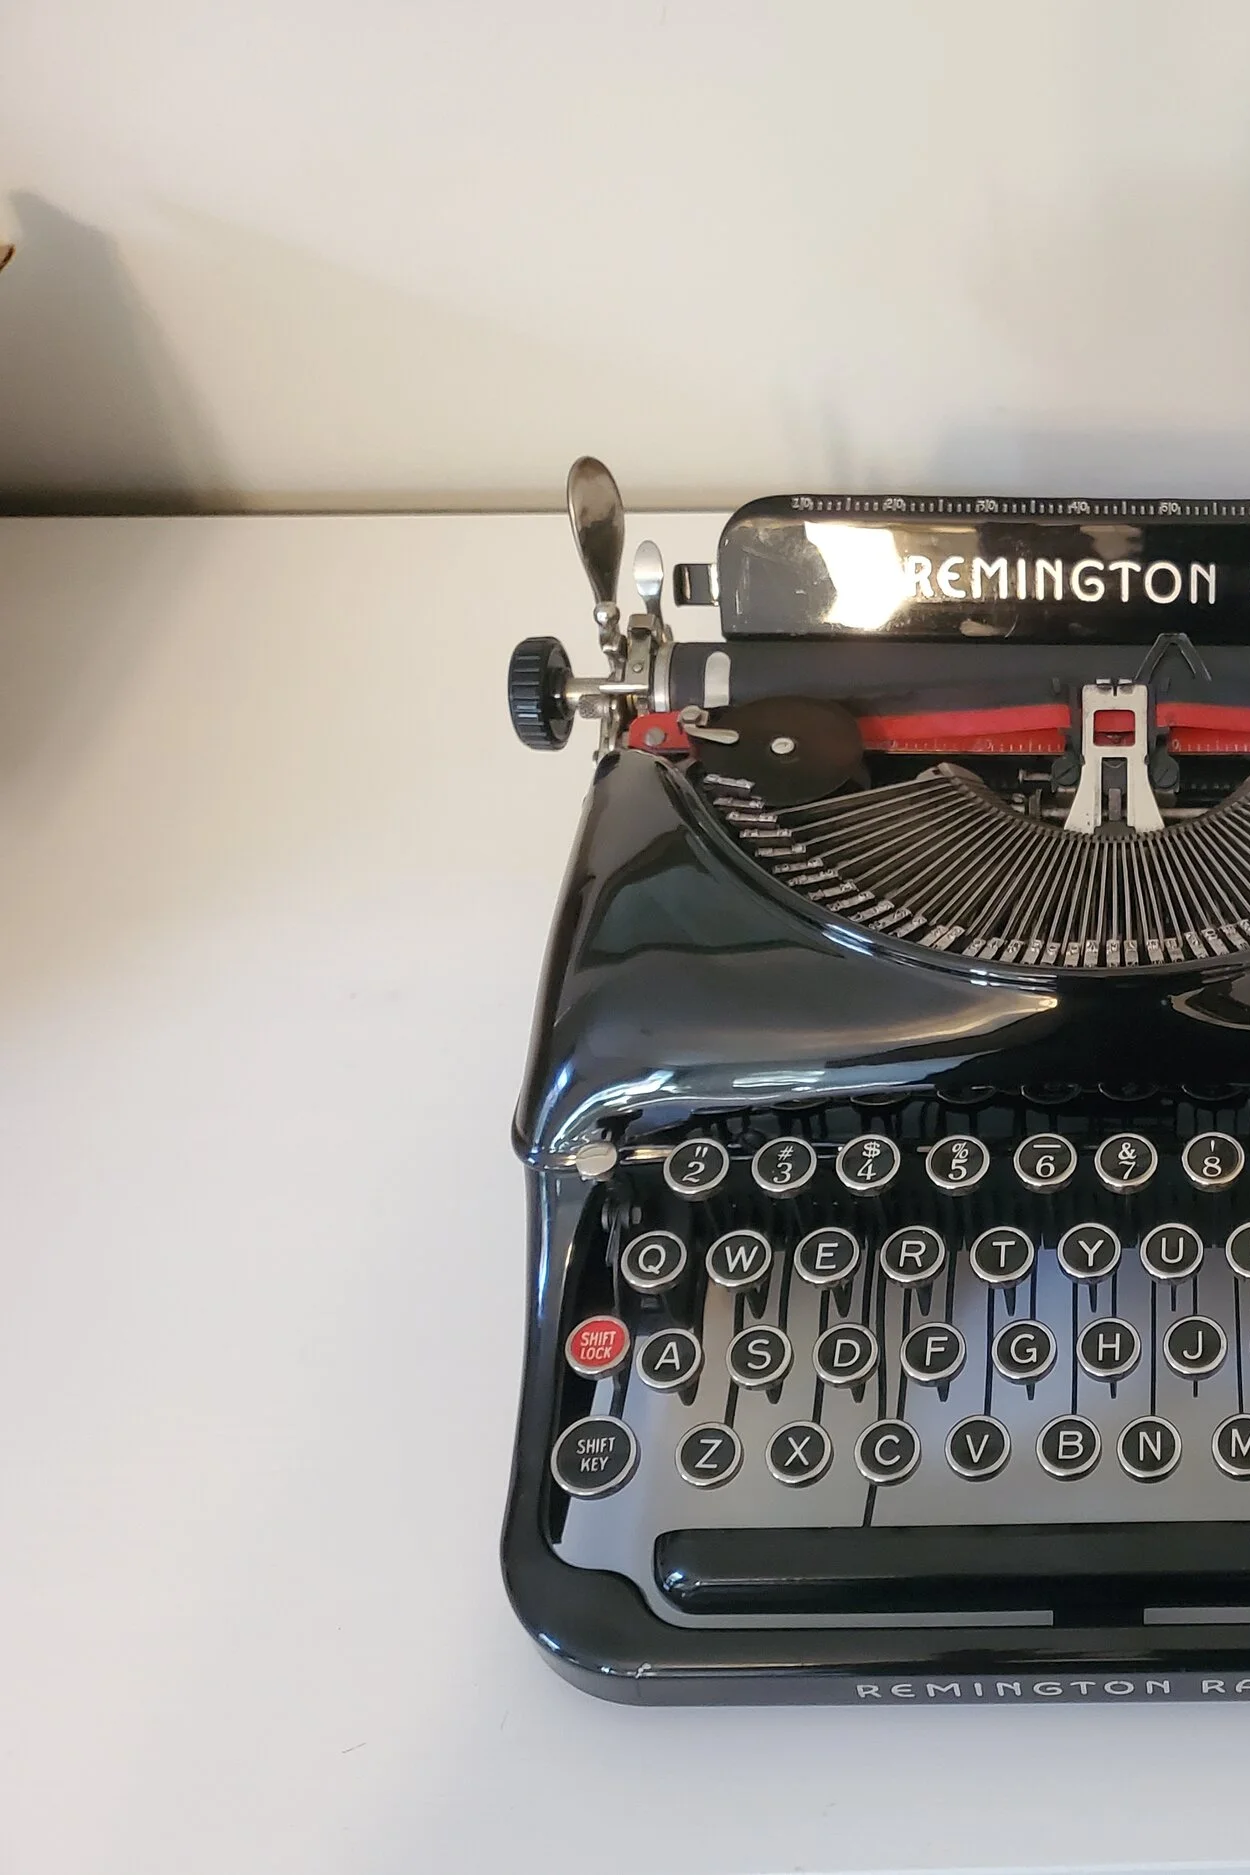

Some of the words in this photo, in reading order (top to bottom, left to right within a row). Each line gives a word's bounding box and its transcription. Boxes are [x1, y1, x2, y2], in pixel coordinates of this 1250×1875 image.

[1161, 502, 1179, 514] 50
[907, 554, 1216, 604] REMINGTON
[695, 1145, 709, 1158] "
[777, 1145, 794, 1161] #
[862, 1141, 881, 1159] $
[951, 1141, 969, 1159] %
[1117, 1142, 1137, 1160] &
[682, 1161, 705, 1183] 2
[773, 1162, 793, 1184] 3
[857, 1158, 877, 1181] 4
[948, 1158, 968, 1181] 5
[1035, 1155, 1055, 1178] 6
[1118, 1160, 1136, 1181] 7
[1202, 1156, 1222, 1177] 8
[638, 1243, 666, 1275] Q
[725, 1245, 759, 1273] W
[815, 1242, 839, 1270] E
[899, 1240, 926, 1268] R
[992, 1240, 1016, 1268] T
[1078, 1239, 1104, 1267] Y
[1161, 1236, 1184, 1264] U
[580, 1330, 617, 1347] SHIFT
[833, 1338, 861, 1367] D
[925, 1336, 949, 1366] F
[1010, 1333, 1037, 1364] G
[1098, 1332, 1121, 1361] H
[1182, 1330, 1203, 1360] J
[580, 1346, 613, 1360] LOCK
[654, 1341, 680, 1371] A
[747, 1338, 772, 1370] S
[576, 1436, 616, 1455] SHIFT
[694, 1438, 723, 1469] Z
[784, 1436, 811, 1467] X
[874, 1434, 901, 1466] C
[965, 1434, 990, 1463] V
[1058, 1430, 1084, 1459] B
[1139, 1430, 1161, 1461] N
[580, 1456, 609, 1472] KEY
[855, 1679, 1172, 1699] REMINGTON
